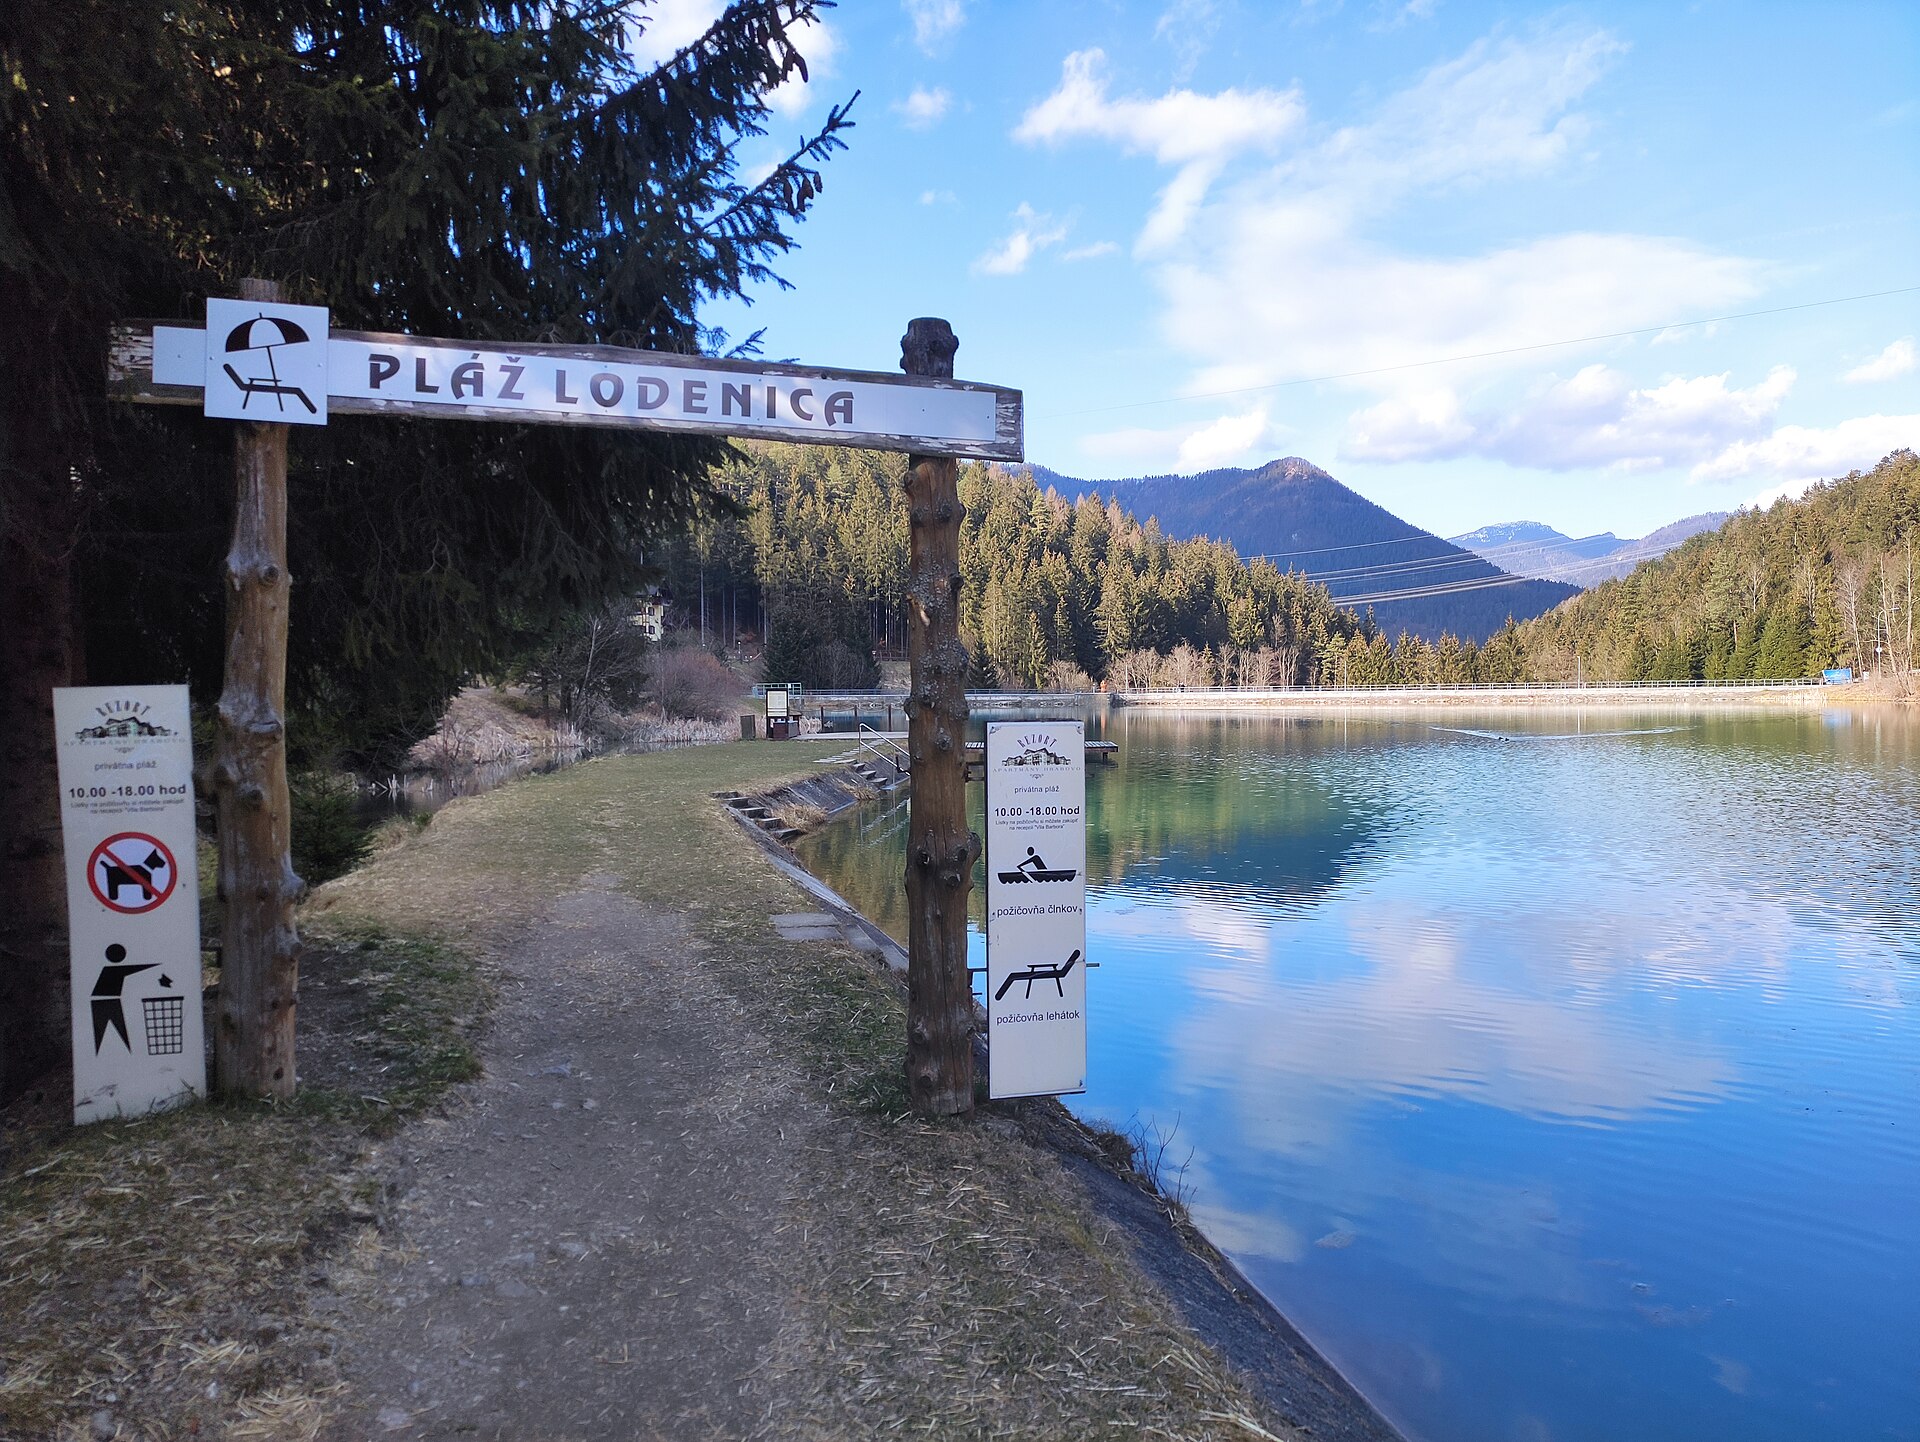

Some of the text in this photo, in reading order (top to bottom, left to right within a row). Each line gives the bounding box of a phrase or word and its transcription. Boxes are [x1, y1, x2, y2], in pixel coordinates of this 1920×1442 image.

[368, 353, 855, 426] PLÁŽ LODENICA
[1017, 733, 1057, 748] REZORT
[94, 760, 157, 771] privátna pláž
[69, 784, 187, 798] 10.00 -18.00 hod
[1014, 785, 1060, 794] privátna pláž
[994, 805, 1080, 817] 10.00 -18.00 hod
[997, 904, 1078, 918] požičovňa člnkov
[996, 1010, 1080, 1026] požičovňa lehátok
